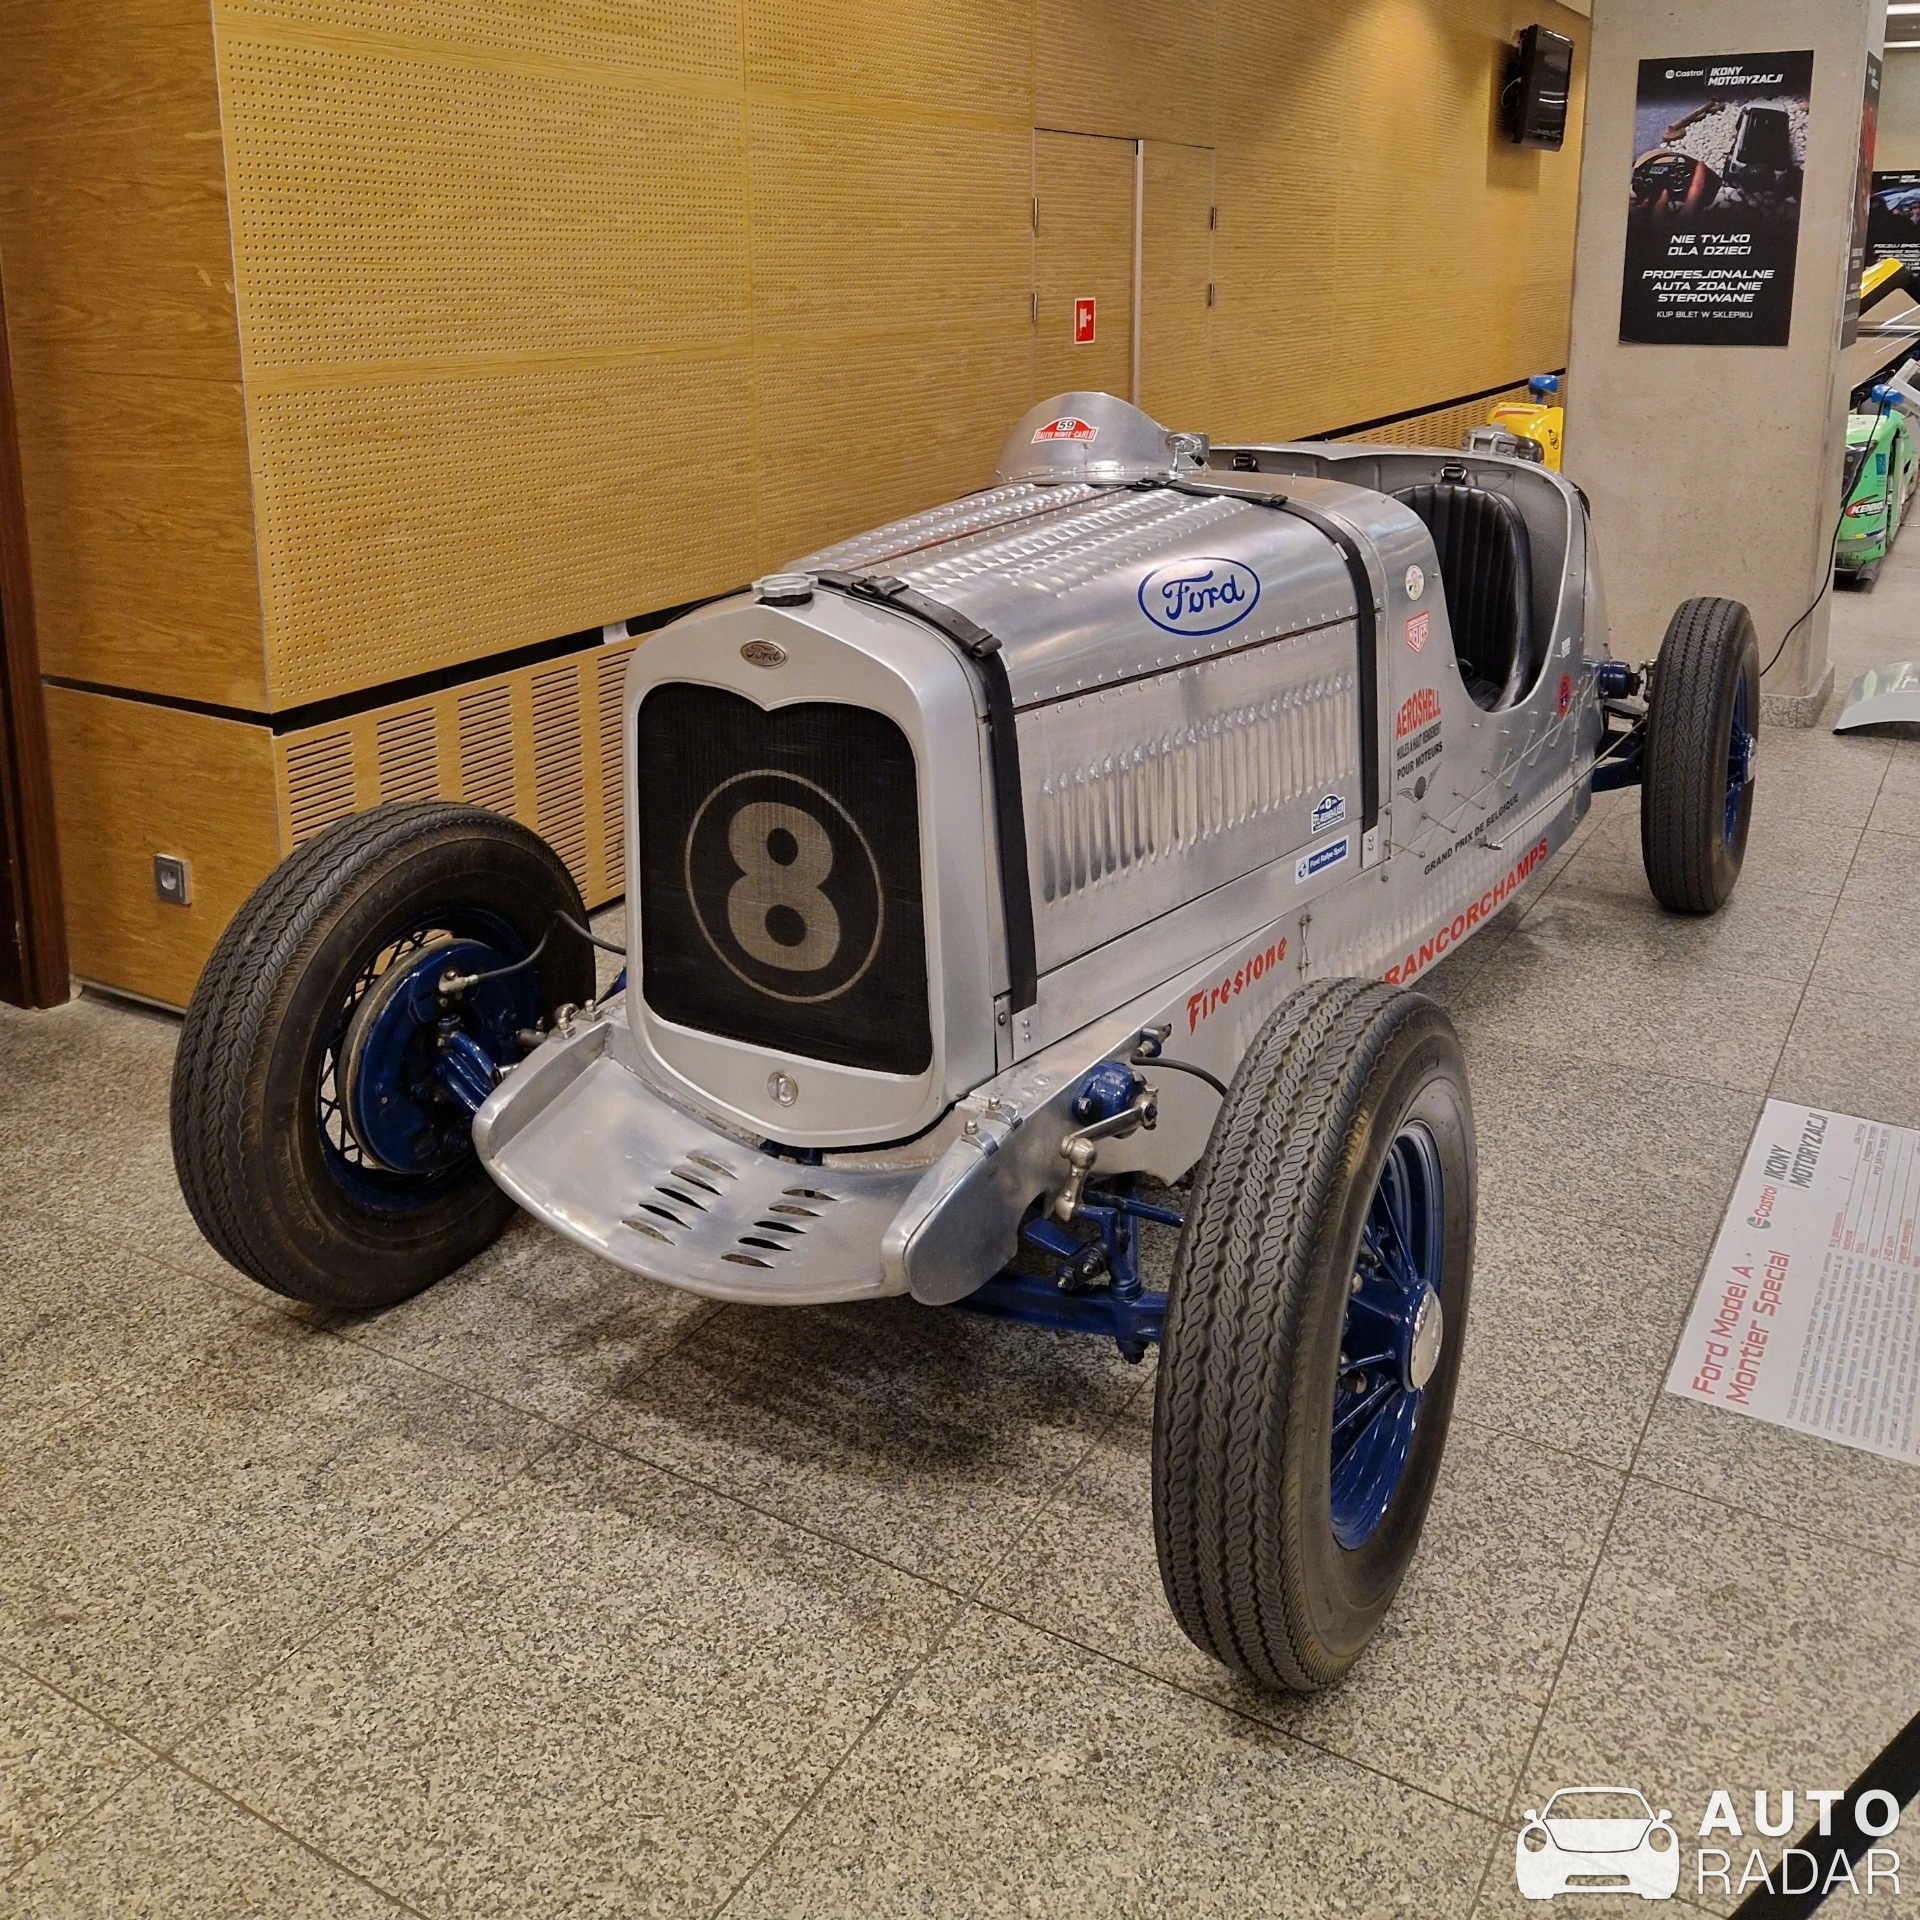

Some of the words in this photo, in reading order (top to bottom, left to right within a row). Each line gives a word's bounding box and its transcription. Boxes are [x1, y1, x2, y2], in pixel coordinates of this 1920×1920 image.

[1675, 69, 1704, 78] Castrol
[1708, 74, 1783, 86] MOTORYZACJI
[1710, 66, 1743, 76] IKONY
[1668, 246, 1698, 255] DLA
[1703, 246, 1751, 255] DZIECI
[1671, 235, 1696, 243] NIE
[1700, 234, 1751, 243] TYLKO
[1642, 270, 1775, 279] PROFESJONALNE
[1652, 282, 1691, 291] AUTA
[1696, 282, 1763, 291] ZDALNIE
[1658, 294, 1755, 303] STEROWANE
[1058, 421, 1075, 430] 59
[1162, 570, 1245, 620] Ford
[745, 643, 781, 661] Ford
[1396, 688, 1441, 739] AEROSHELL
[1397, 760, 1415, 781] POUR
[1415, 741, 1443, 769] MOTEURS
[1424, 847, 1453, 875] GRAND
[1454, 831, 1473, 853] PRIX
[1474, 821, 1485, 836] DE
[1486, 792, 1519, 828] BELGIQUE
[728, 802, 840, 971] 8
[1378, 837, 1548, 985] RANCORCHAMPS
[1186, 936, 1288, 1036] Firestone
[1763, 1144, 1792, 1180] IKONY
[1789, 1112, 1829, 1188] MOTORYZACJI
[1754, 1184, 1778, 1217] Castrol
[1731, 1265, 1754, 1279] A
[1710, 1280, 1749, 1339] Model
[1725, 1319, 1769, 1405] Montier
[1752, 1250, 1791, 1317] Special
[1692, 1341, 1729, 1395] Ford
